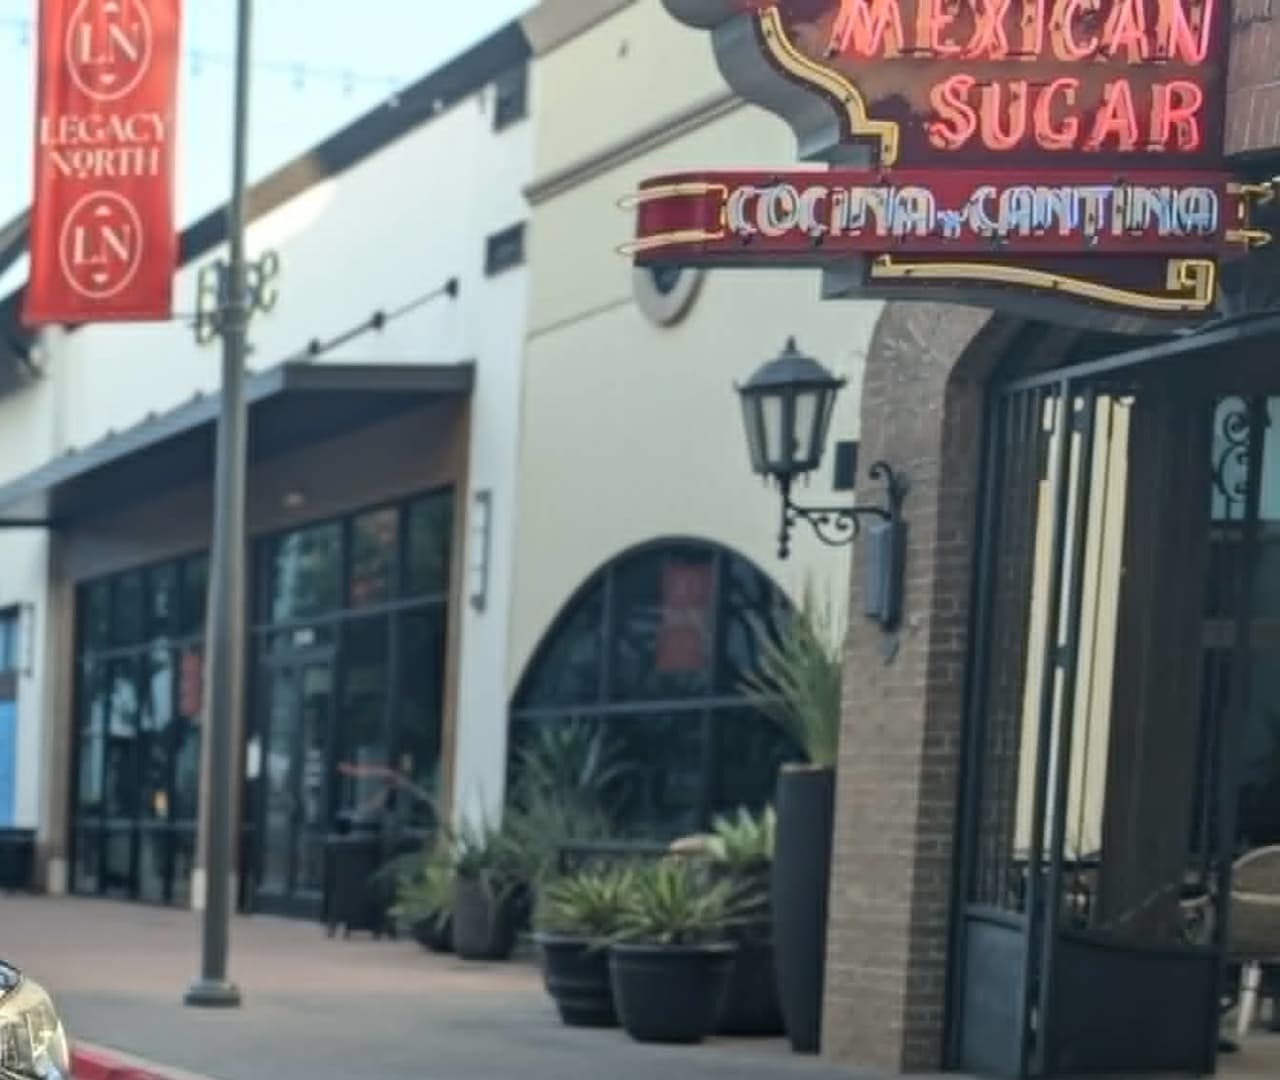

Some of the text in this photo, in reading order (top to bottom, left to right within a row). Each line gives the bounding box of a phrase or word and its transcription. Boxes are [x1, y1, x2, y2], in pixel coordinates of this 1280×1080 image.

[827, 0, 1212, 63] MEXICAN
[41, 112, 165, 146] LEGACY
[927, 74, 1204, 151] SUGAR
[49, 148, 160, 179] NORTH
[726, 183, 935, 237] COCINA
[968, 185, 1219, 237] CANTINA
